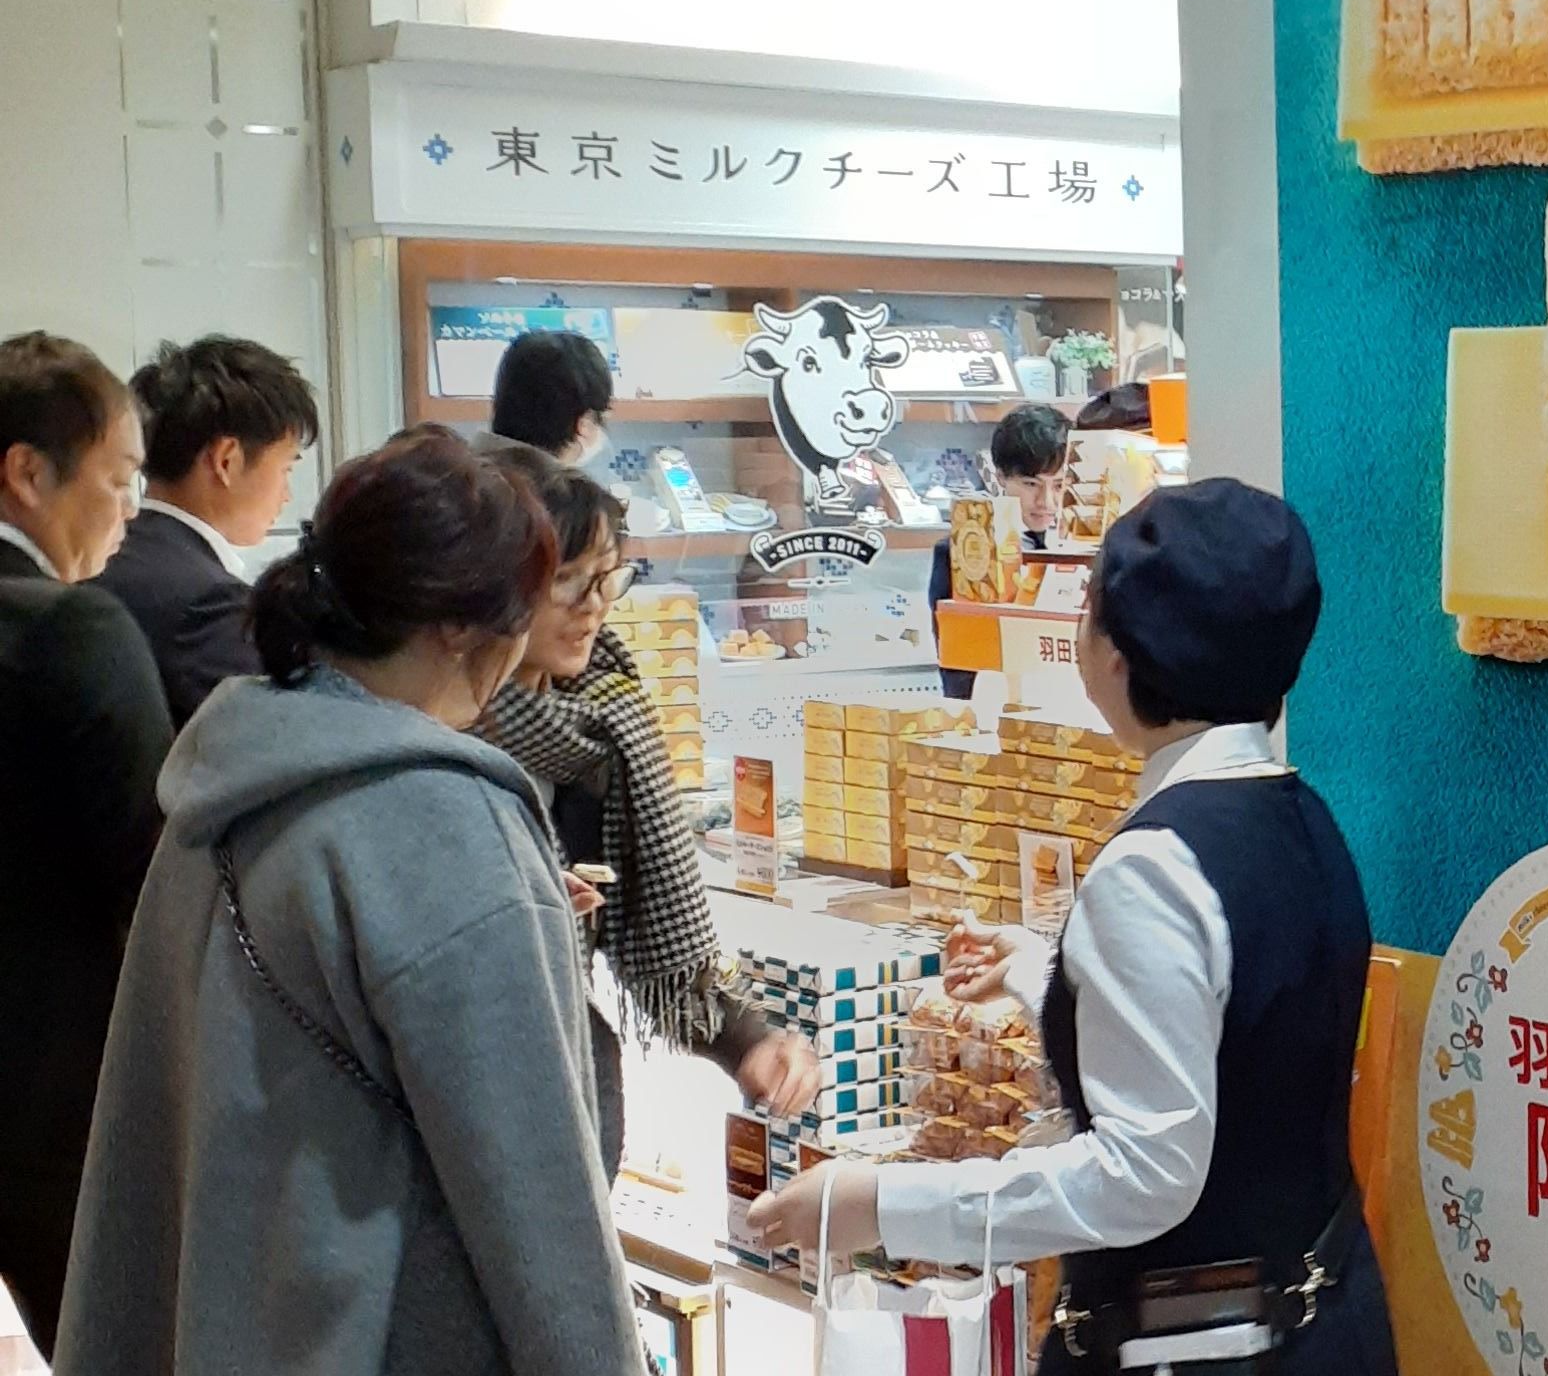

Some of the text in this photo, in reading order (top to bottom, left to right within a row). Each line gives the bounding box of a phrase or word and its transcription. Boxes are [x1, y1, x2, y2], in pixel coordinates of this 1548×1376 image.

[485, 125, 1100, 205] 東京ミルクチーズ工場
[771, 604, 808, 616] MADE
[1039, 635, 1080, 663] 羽田
